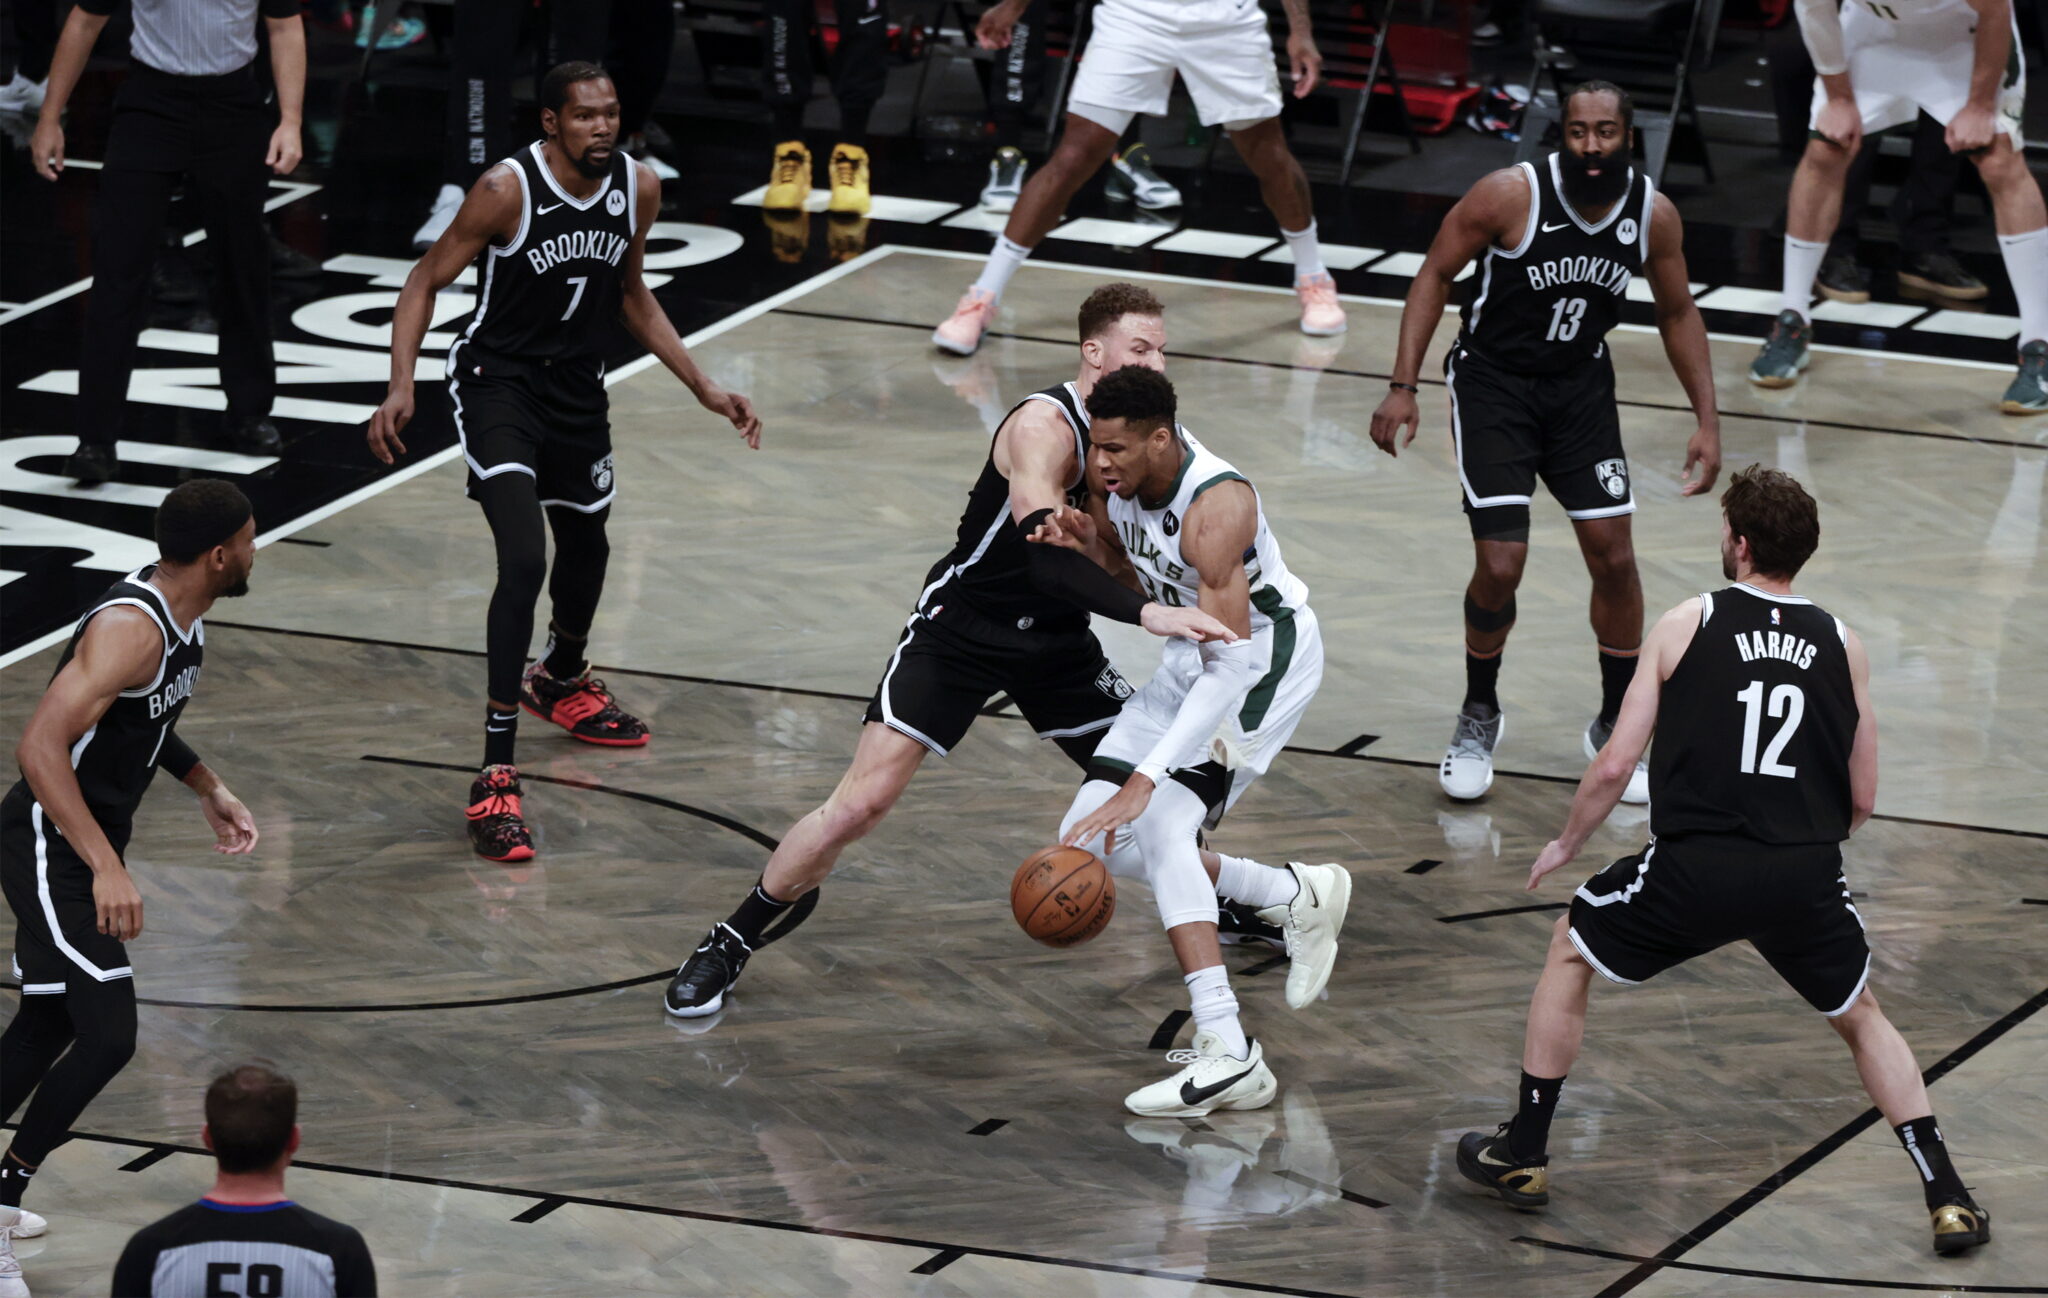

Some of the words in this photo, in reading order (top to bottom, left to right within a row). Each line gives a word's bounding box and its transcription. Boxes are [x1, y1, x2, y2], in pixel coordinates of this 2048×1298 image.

[468, 79, 485, 133] BROOKLYN
[469, 137, 486, 164] NETS
[527, 230, 628, 275] BROOKLYN
[560, 276, 588, 321] 7
[1526, 256, 1632, 296] BROOKLYN
[1546, 297, 1587, 341] 13
[1111, 520, 1184, 581] UCKS
[1734, 630, 1817, 670] HARRIS
[1737, 680, 1805, 779] 12
